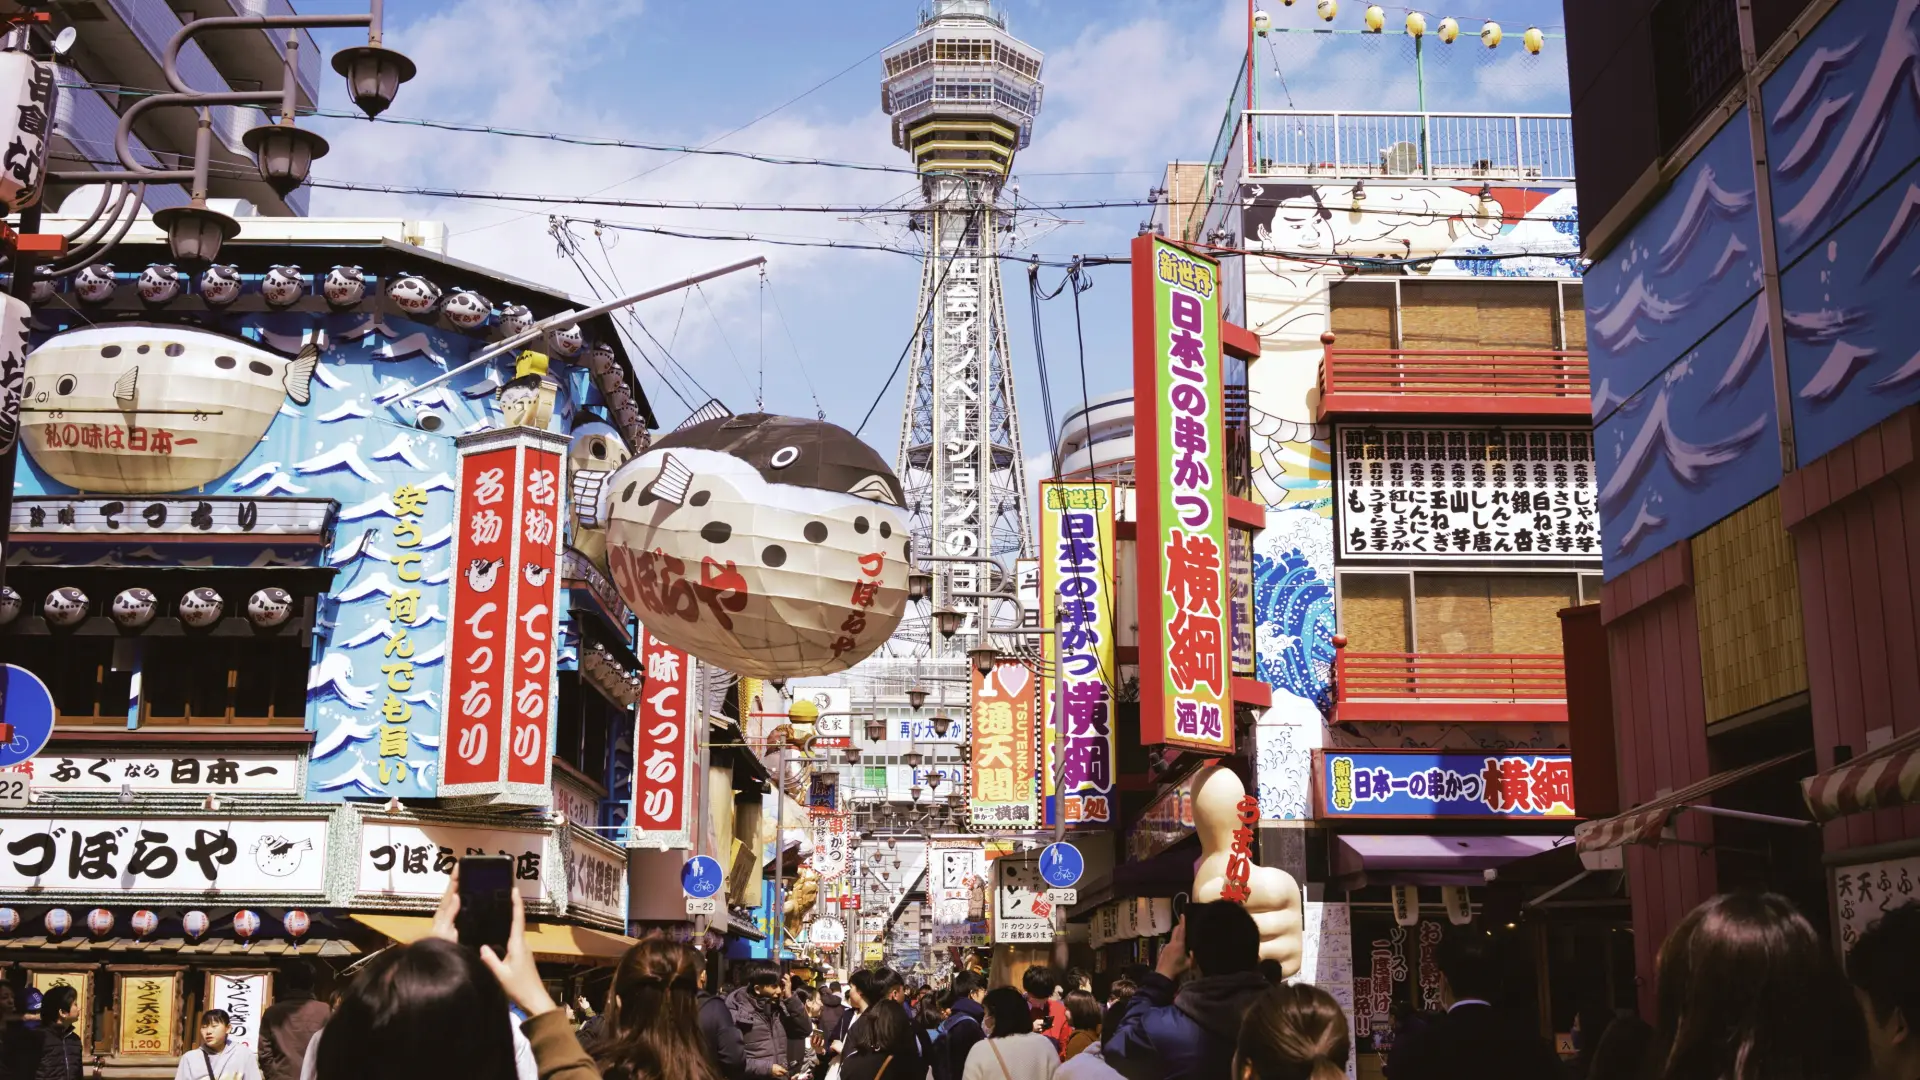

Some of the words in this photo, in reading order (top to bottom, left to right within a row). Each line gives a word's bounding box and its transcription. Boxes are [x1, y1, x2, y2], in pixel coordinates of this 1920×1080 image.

[1158, 248, 1213, 297] 新世界
[45, 423, 198, 454] 私の味は日本一
[1170, 291, 1210, 527] 日本一の串かつ
[471, 467, 505, 546] 名物
[525, 467, 556, 546] 名物
[1047, 487, 1107, 510] 新世界
[1348, 489, 1367, 552] もち
[1368, 489, 1389, 552] うずら玉子
[1388, 489, 1410, 552] 紅しょうが
[1408, 489, 1429, 552] にんにく
[1430, 489, 1451, 552] 玉ねぎ
[1450, 489, 1471, 552] 山芋
[1471, 490, 1492, 552] しし唐
[1491, 490, 1513, 552] れんこん
[1511, 490, 1533, 552] 銀杏
[1533, 490, 1554, 552] 白ねぎ
[1553, 490, 1574, 552] さつま芋
[1574, 490, 1594, 552] じゃが芋
[830, 551, 888, 658] づぼらや
[1059, 513, 1099, 676] 日本一の串かつ
[1166, 529, 1223, 697] 横綱
[378, 483, 428, 785] 安うて何んでも旨い
[643, 634, 680, 823] 味てっちり
[900, 721, 961, 738] 再び大か
[1050, 680, 1110, 791] 横綱
[1176, 700, 1222, 738] 酒処
[50, 757, 116, 782] ふぐ
[124, 762, 160, 779] なら
[170, 757, 278, 785] 日本一
[977, 701, 1014, 801] 通天閣
[1015, 701, 1029, 800] TSUTENKAKU
[994, 804, 1030, 821] 横綱
[1334, 759, 1351, 808] 新世界
[1354, 770, 1480, 801] 日本一の串かつ
[1482, 758, 1575, 810] 横綱
[6, 826, 239, 881] づぼらや
[369, 842, 541, 880] づぼら店
[829, 817, 845, 861] 串かつ
[135, 980, 161, 1036] ふぐ天ぷら
